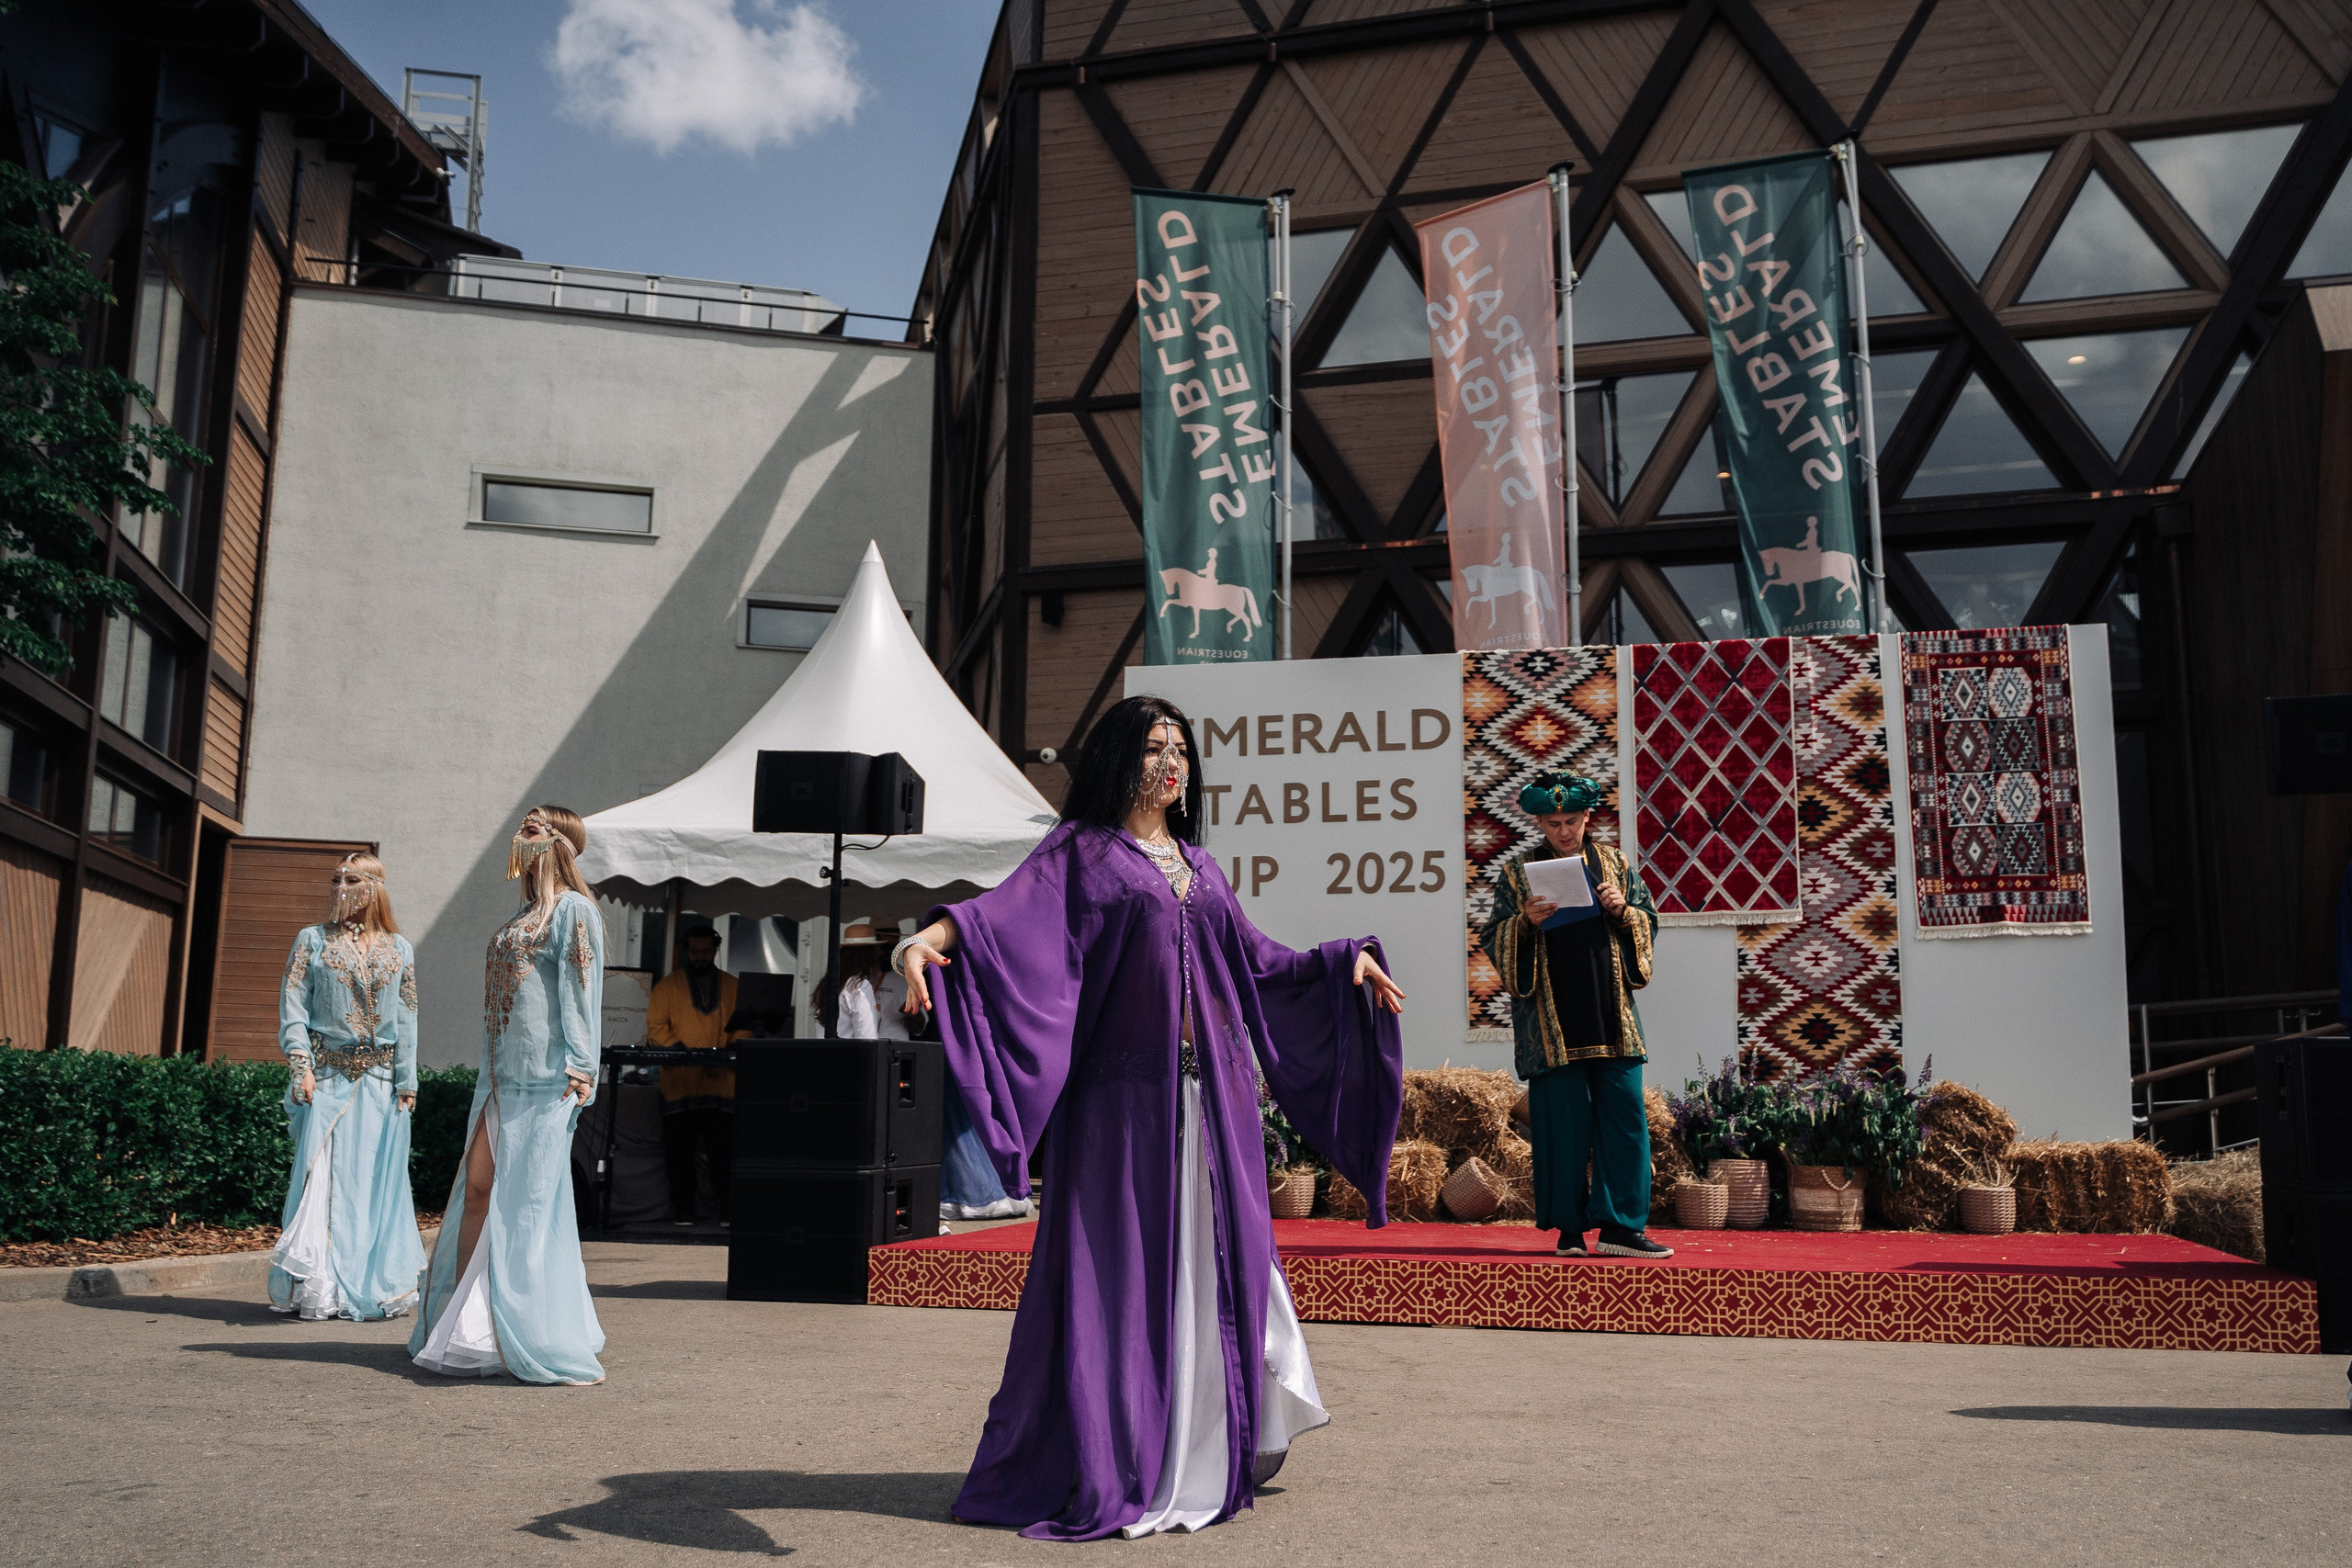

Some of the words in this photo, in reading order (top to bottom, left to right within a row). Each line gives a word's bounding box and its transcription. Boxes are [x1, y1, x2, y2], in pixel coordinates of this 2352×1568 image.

[1185, 707, 1451, 758] MERALD
[1202, 777, 1418, 826] TABLES
[1327, 850, 1446, 896] 2025
